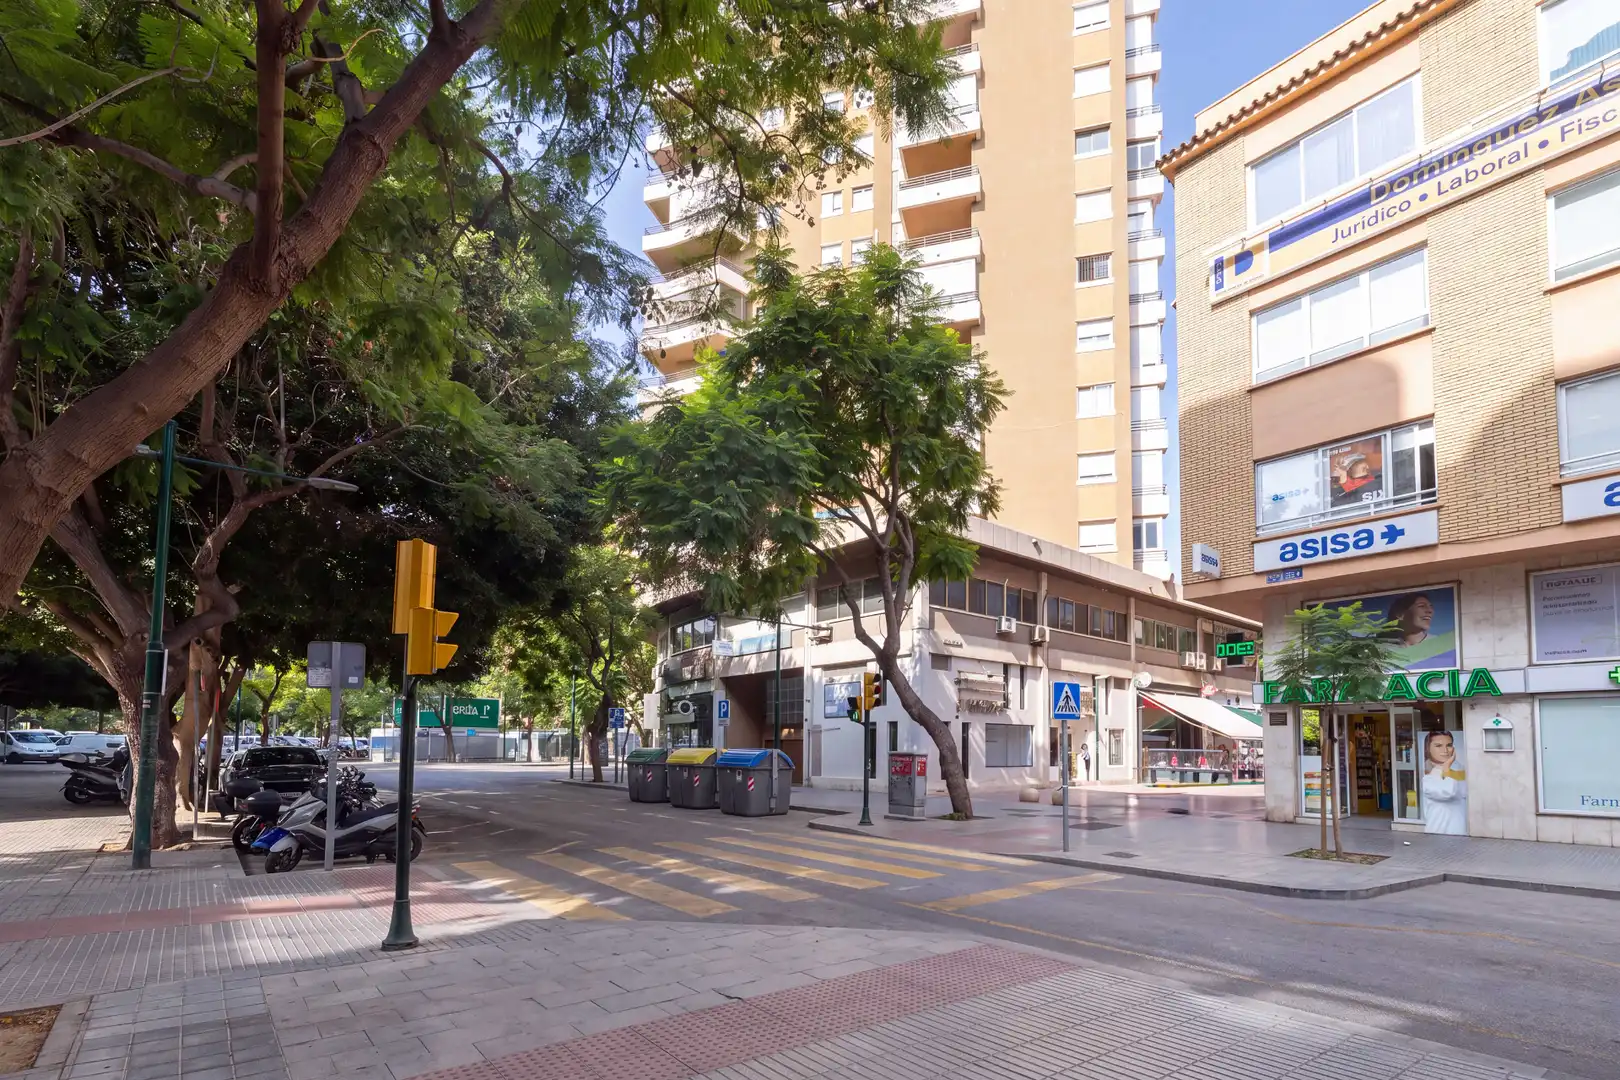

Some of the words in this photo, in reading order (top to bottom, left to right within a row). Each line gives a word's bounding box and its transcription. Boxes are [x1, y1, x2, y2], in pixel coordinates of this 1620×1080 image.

[1331, 198, 1412, 244] Jurídico
[1436, 141, 1530, 196] Laboral
[1559, 107, 1619, 143] Fisc
[1279, 528, 1375, 563] asisa
[720, 701, 728, 718] P
